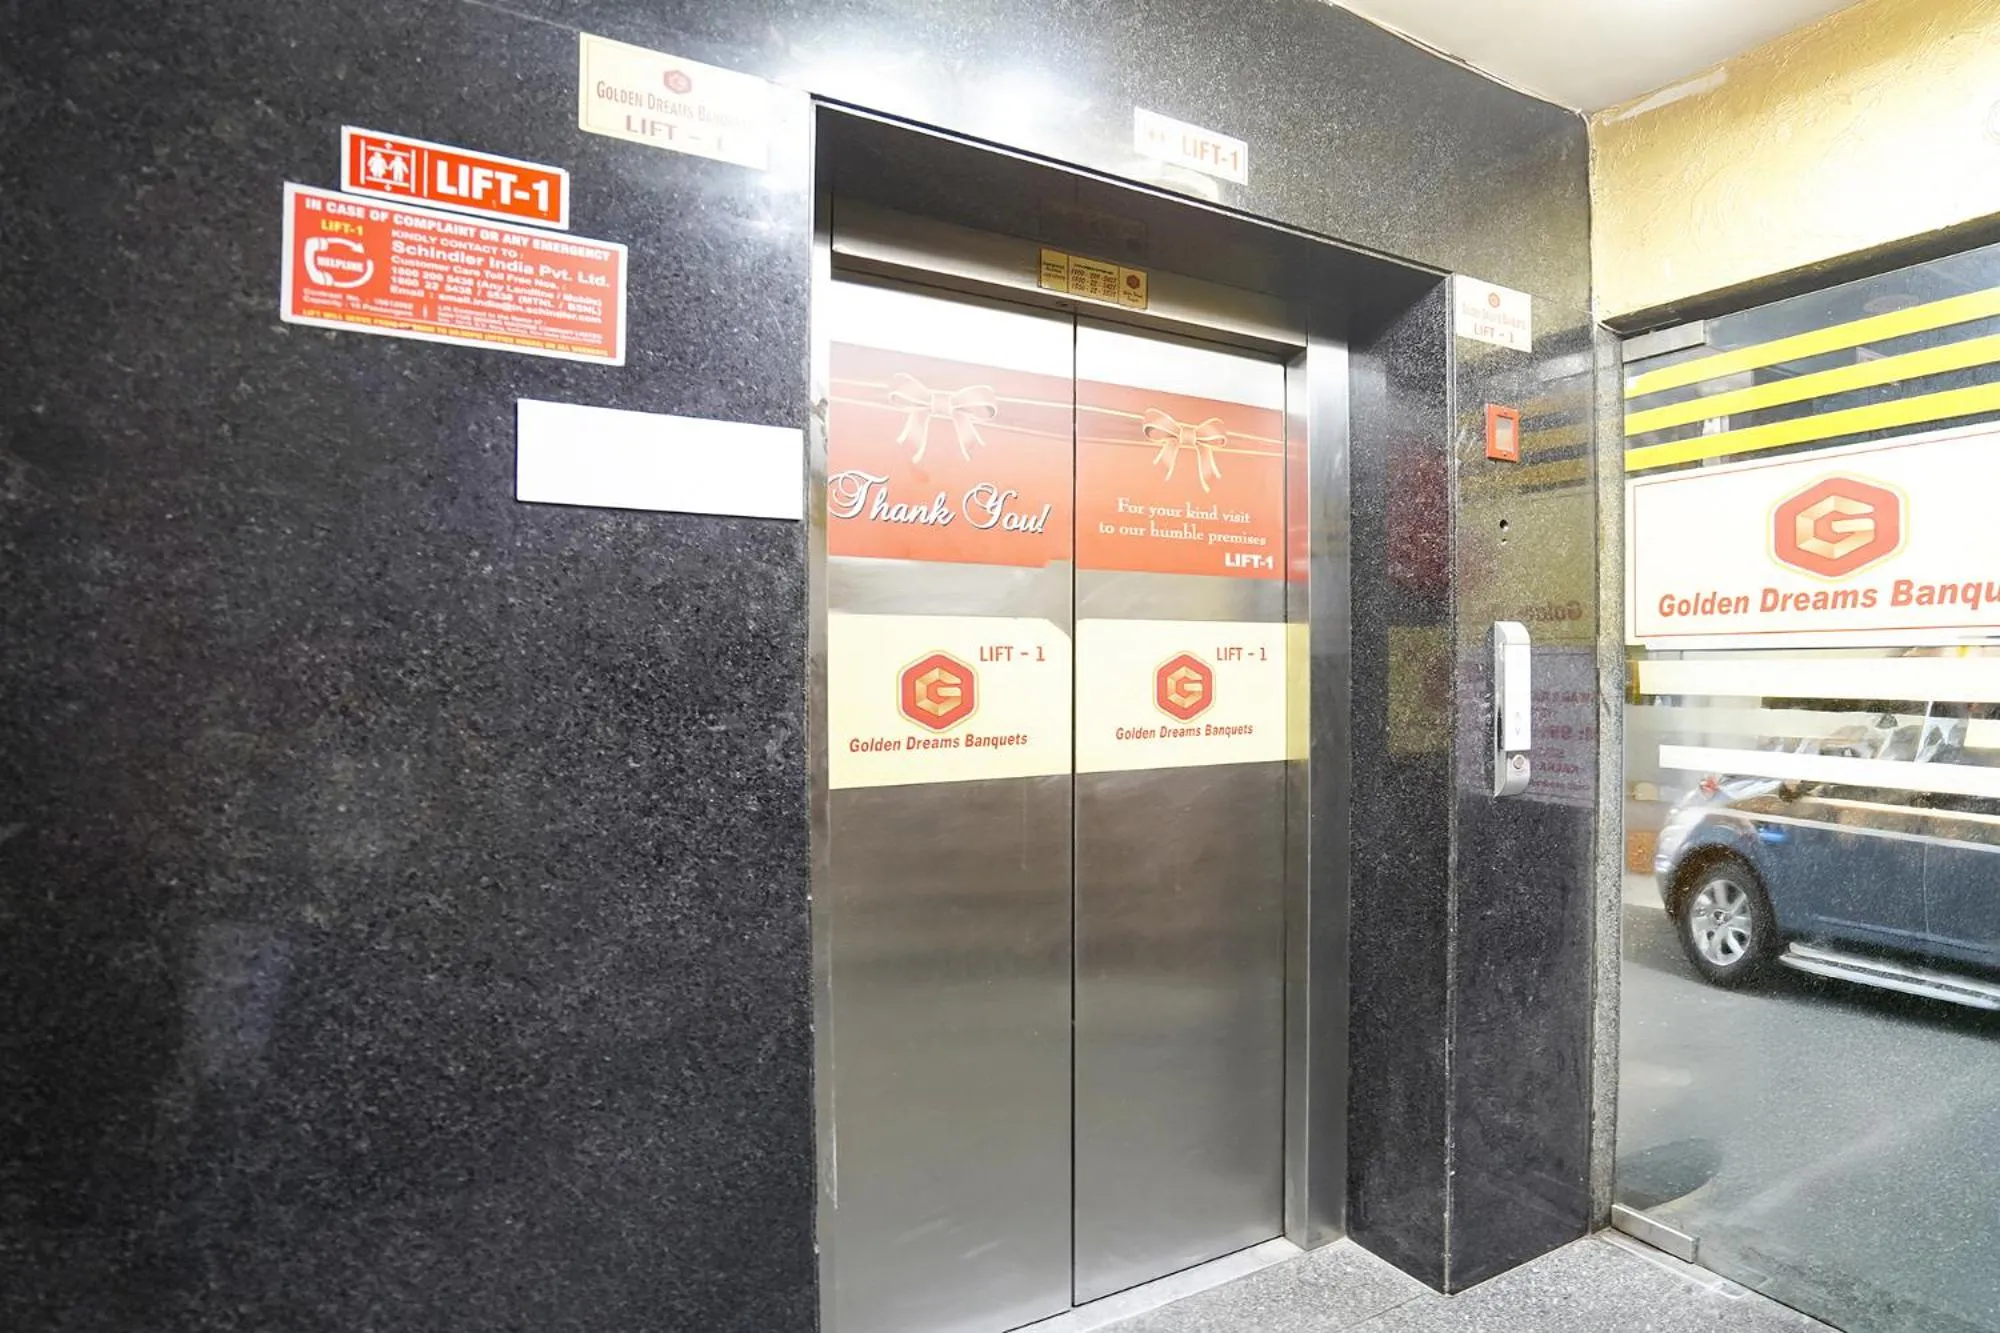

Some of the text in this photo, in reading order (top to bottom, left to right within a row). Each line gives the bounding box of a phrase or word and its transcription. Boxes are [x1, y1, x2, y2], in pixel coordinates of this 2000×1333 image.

[596, 80, 643, 108] GOLDEN
[626, 114, 677, 140] LIFT
[437, 159, 549, 212] LIFT-1
[305, 197, 610, 261] IN CASE OF COMPLAINT OR ANY EMERGENCY
[321, 218, 363, 236] LIFT-1
[439, 238, 497, 254] CONTACT
[500, 248, 517, 258] TO
[392, 240, 610, 287] Schindler India Pvt. Ltd.
[828, 470, 1052, 533] Thank You!
[1117, 498, 1251, 523] For your kind visit
[1099, 521, 1267, 546] to our humble premises
[1225, 553, 1273, 570] LIFT-1
[1657, 591, 1750, 617] Golden
[1759, 584, 1878, 613] Dreams
[979, 645, 1014, 662] LIFT
[1035, 646, 1046, 662] 1
[1216, 647, 1243, 661] LIFT
[1259, 647, 1268, 661] 1
[849, 733, 1028, 753] Golden Dreams Banquets
[1115, 724, 1253, 740] Golden Dreams Banquets
